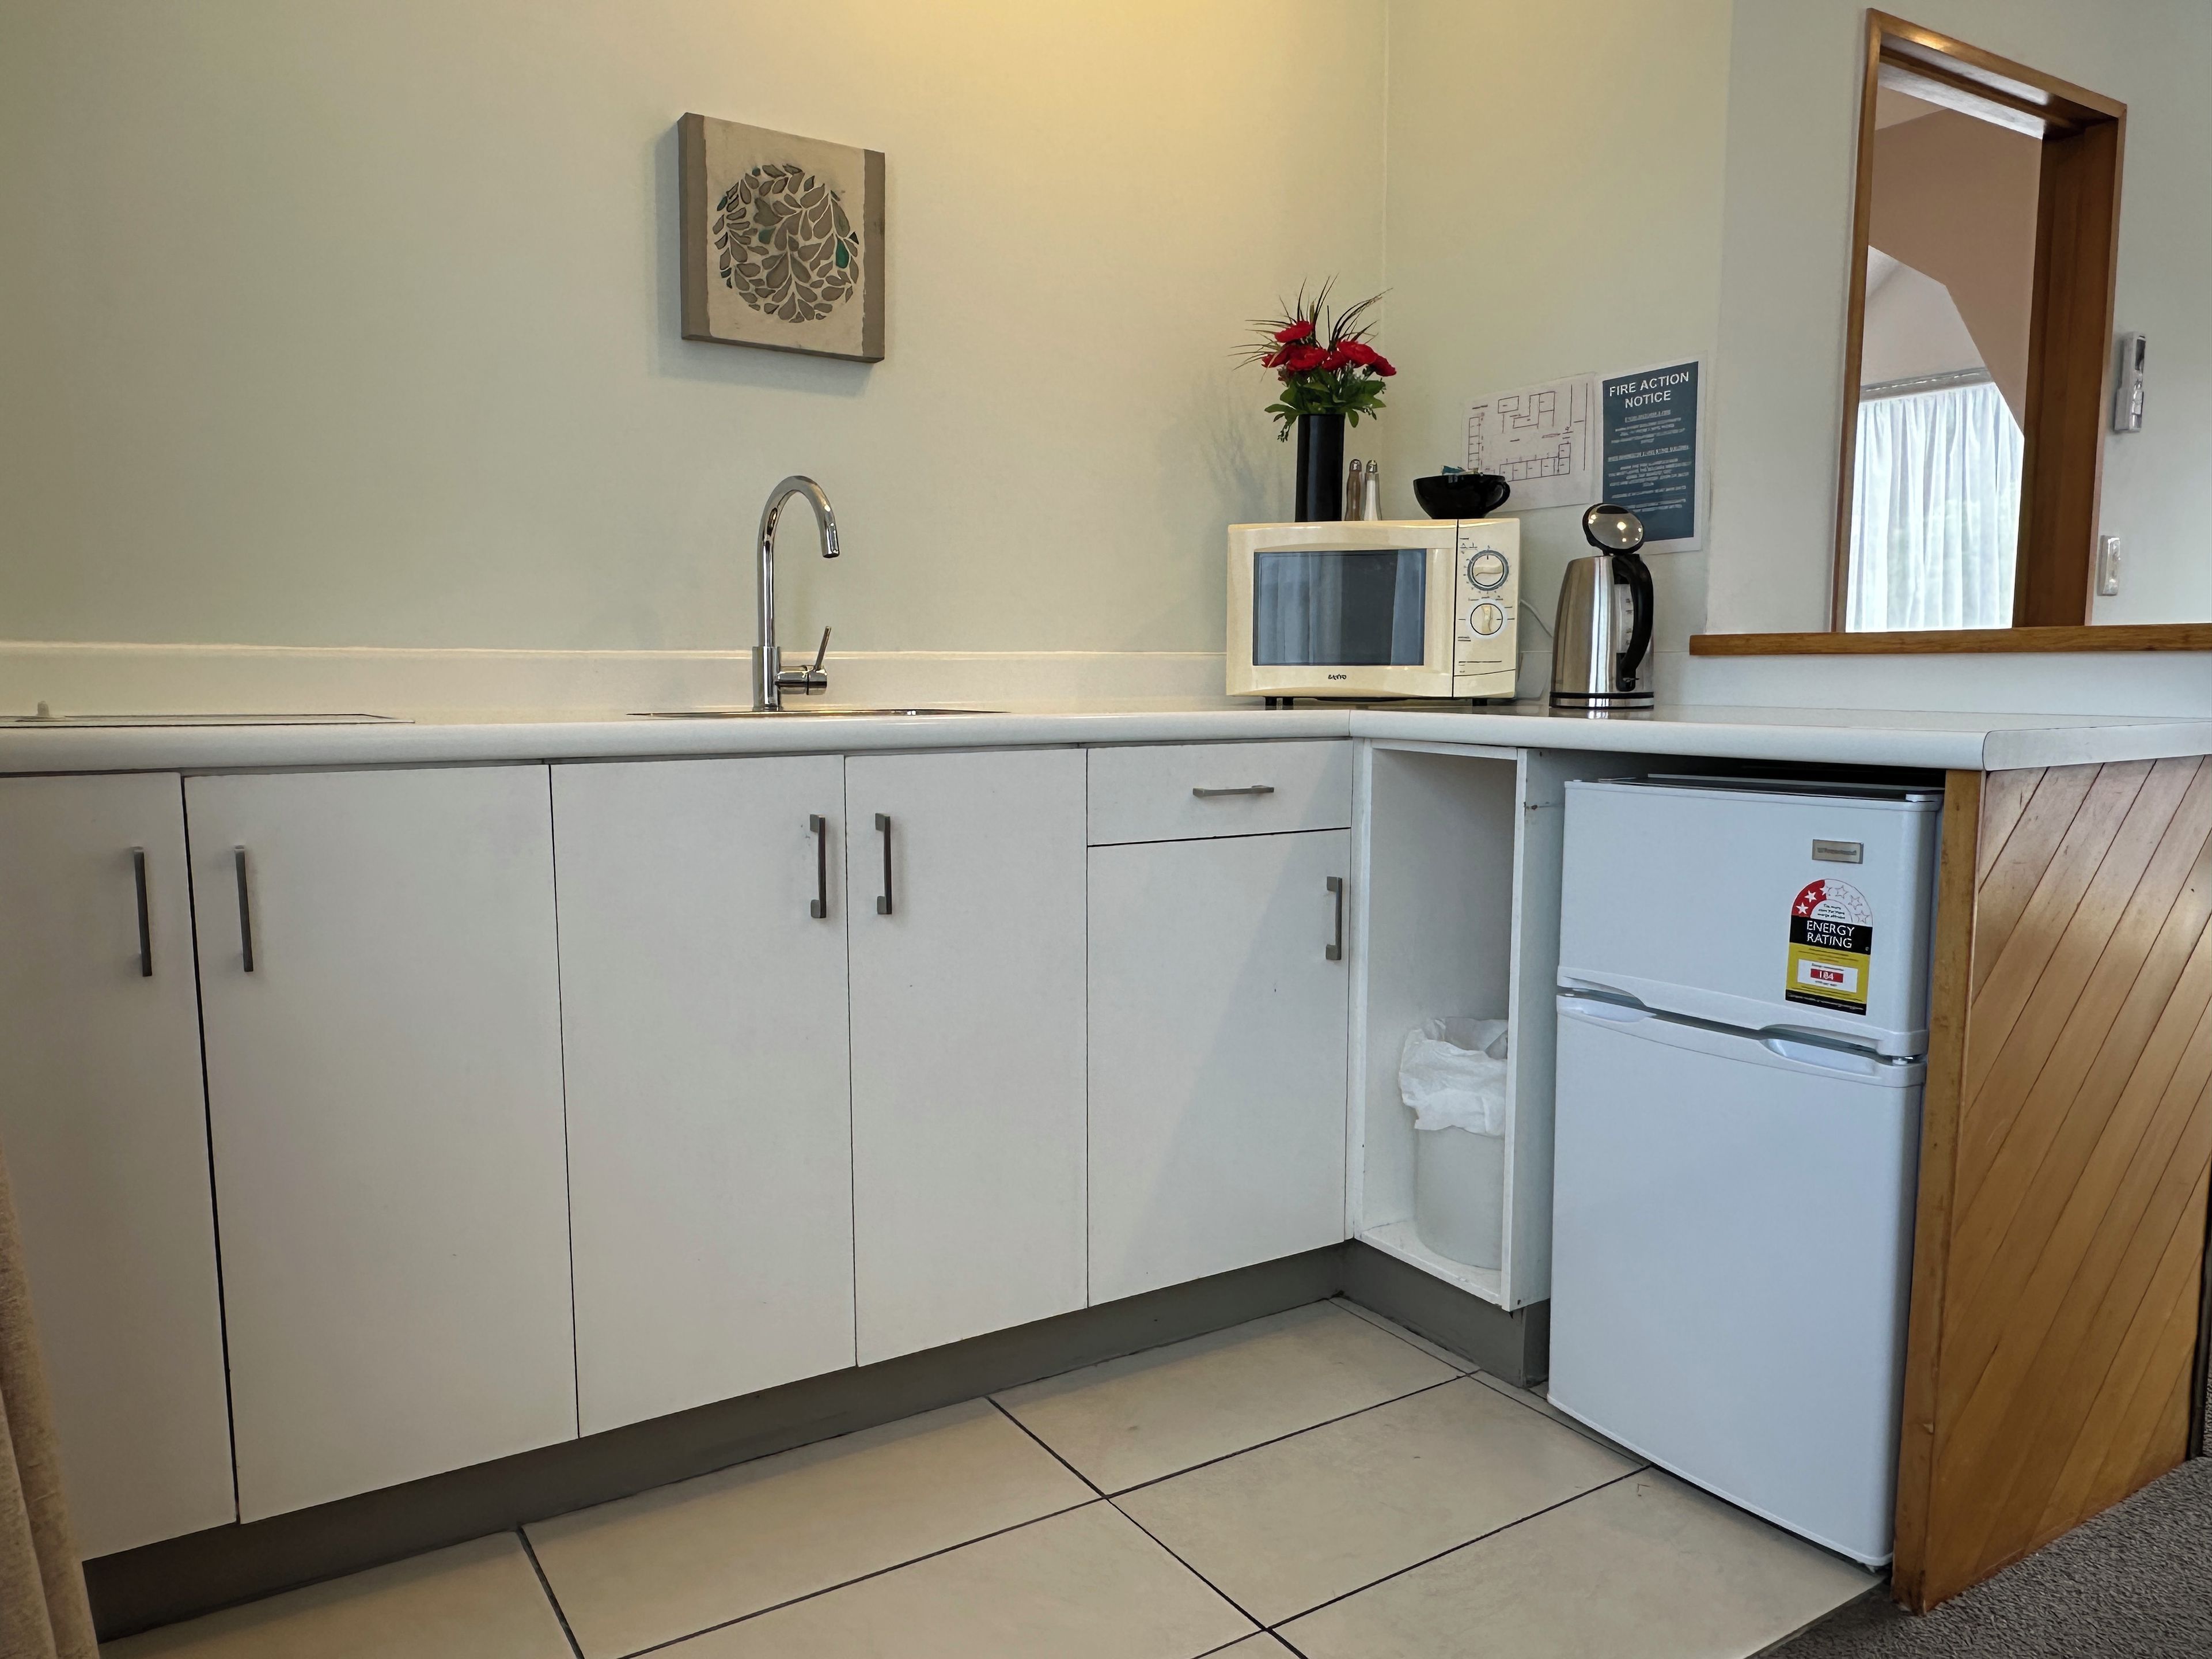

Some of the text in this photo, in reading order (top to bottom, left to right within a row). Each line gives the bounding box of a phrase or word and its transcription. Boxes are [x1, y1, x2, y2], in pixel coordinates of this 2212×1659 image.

[1609, 372, 1689, 397] FIRE ACTION
[1625, 391, 1671, 408] NOTICE
[1807, 921, 1855, 937] ENERGY
[1807, 932, 1852, 948] RATING
